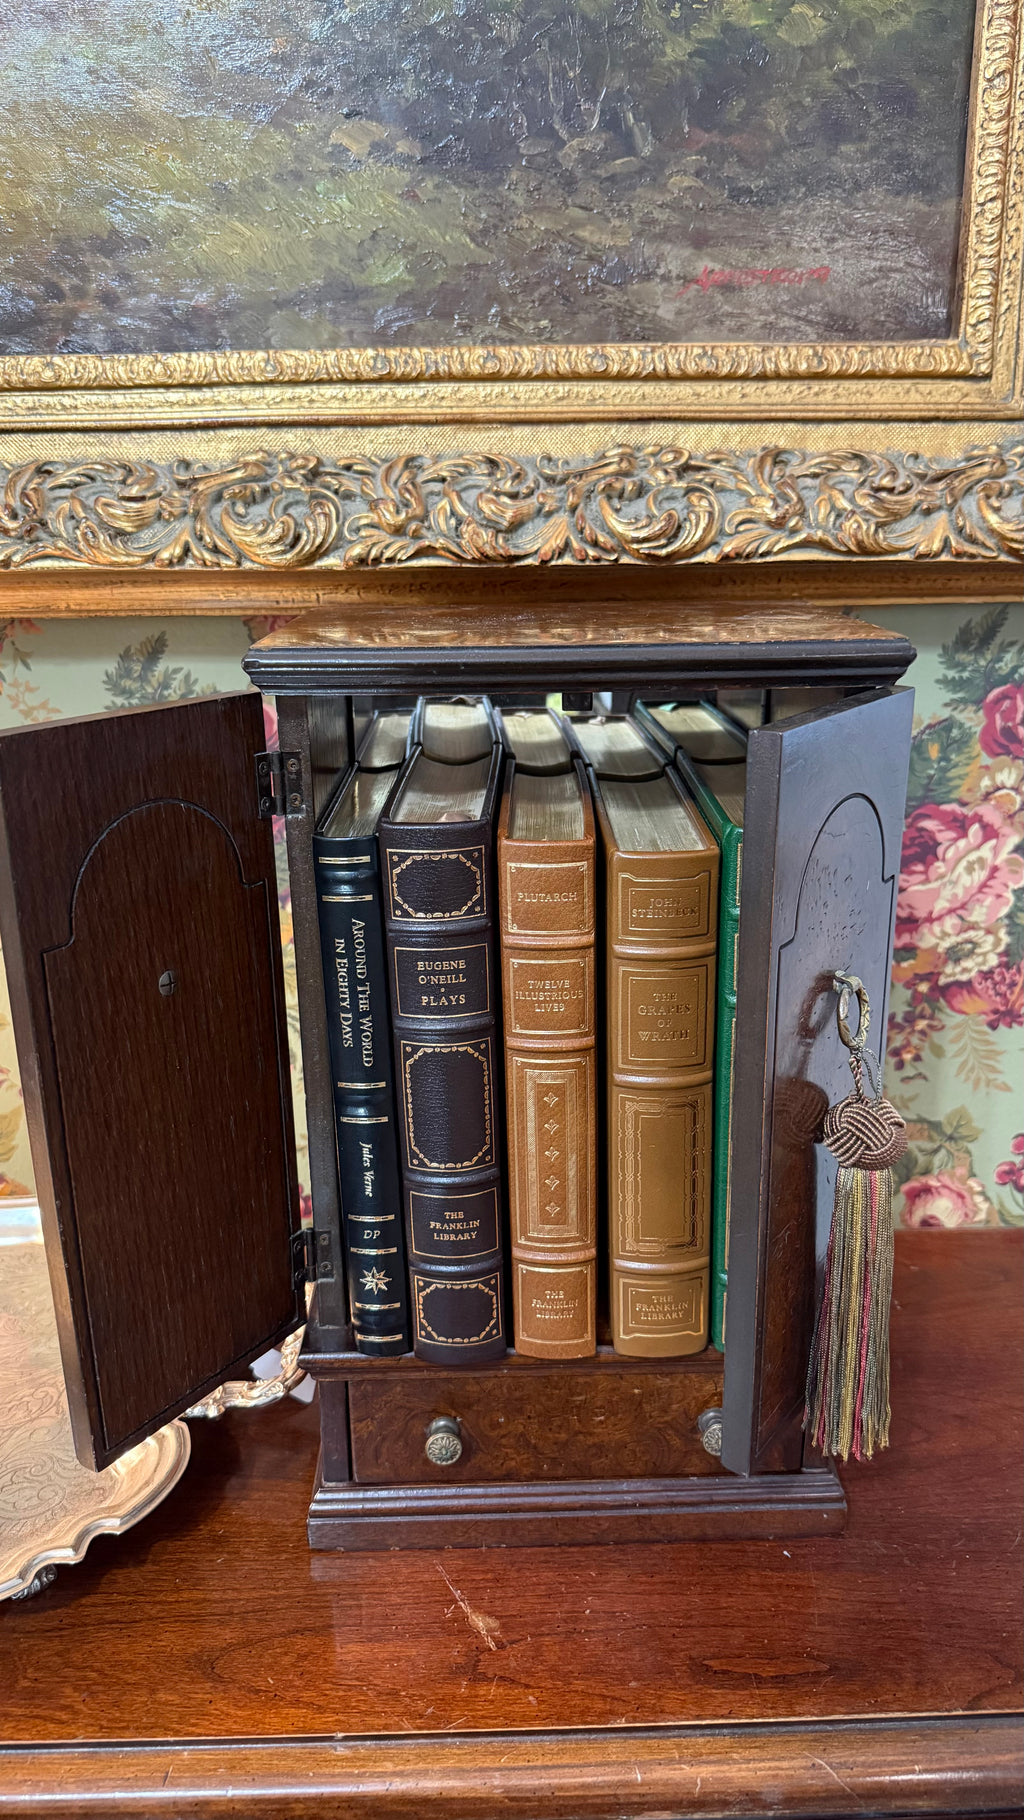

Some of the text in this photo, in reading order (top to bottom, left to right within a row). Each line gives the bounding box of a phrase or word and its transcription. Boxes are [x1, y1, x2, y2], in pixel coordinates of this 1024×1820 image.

[517, 892, 578, 902] PLUTARCH
[649, 898, 682, 908] JOHN
[632, 907, 698, 918] STEINBECK
[417, 960, 466, 971] EUGENE
[418, 974, 466, 984] O'NEILL
[528, 980, 570, 989] TWELVE
[334, 938, 353, 1048] IN EIGHTY DAYS
[352, 918, 367, 979] AROUND
[360, 1015, 374, 1067] WORLD
[515, 990, 584, 1000] ILLUSTRIOUS
[653, 993, 677, 1001] THE
[421, 994, 466, 1006] PLAYS
[534, 1003, 565, 1012] LIVES
[638, 1005, 690, 1016] GRAPES
[658, 1019, 672, 1028] OF
[638, 1030, 690, 1042] WRATH
[359, 1142, 374, 1198] Jules Verne
[444, 1212, 464, 1220] THE
[430, 1220, 480, 1230] FRANKLIN
[364, 1230, 381, 1240] DP
[434, 1231, 477, 1241] LIBRARY
[545, 1290, 564, 1299] THE
[652, 1295, 674, 1303] THE
[532, 1298, 578, 1309] FRANKLIN
[636, 1301, 689, 1312] FRANKLIN
[536, 1310, 574, 1320] LIBRARY
[640, 1310, 684, 1320] LIBRARY
